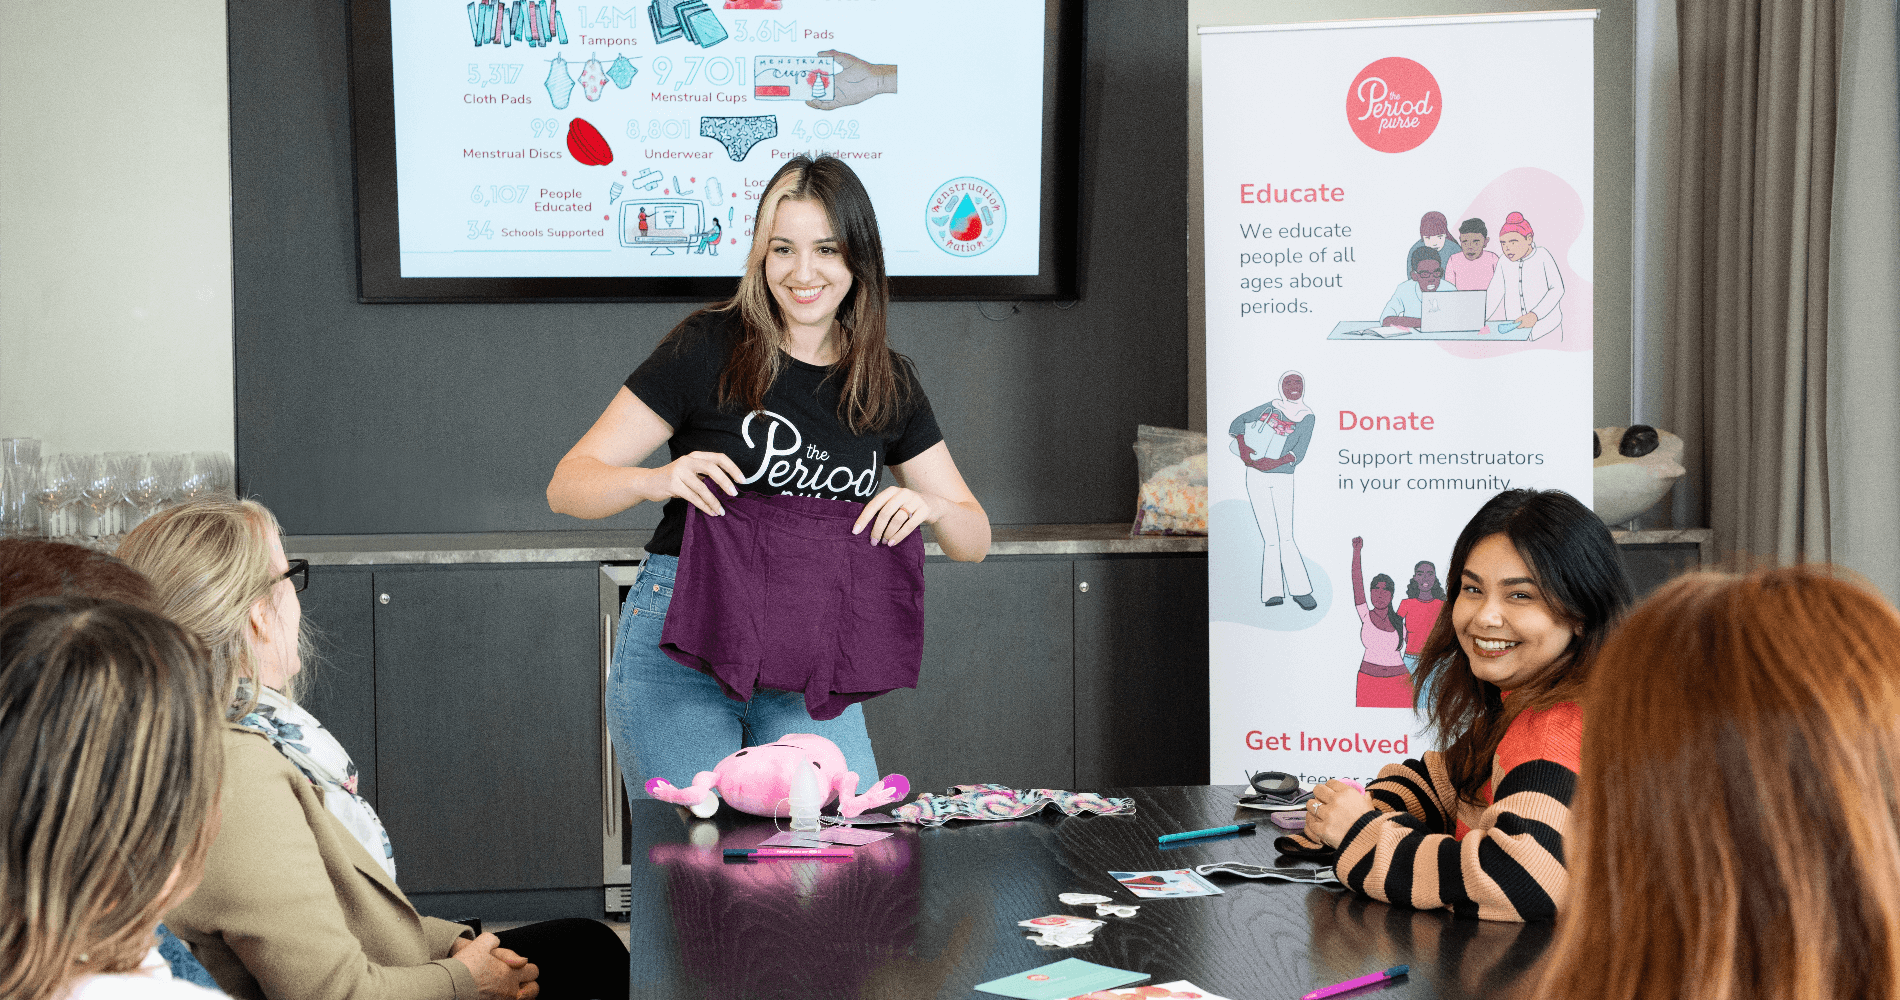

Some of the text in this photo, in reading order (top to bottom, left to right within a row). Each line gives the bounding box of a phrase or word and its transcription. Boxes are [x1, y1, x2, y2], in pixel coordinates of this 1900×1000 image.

[577, 5, 637, 29] 1.4M
[579, 35, 637, 47] Tampons
[733, 19, 798, 43] 3.6M
[804, 28, 835, 40] Pads
[467, 63, 524, 89] 5,317
[651, 55, 747, 92] 9,701
[463, 93, 532, 104] Cloth Pads
[651, 92, 747, 105] Menstrual Cups
[1357, 77, 1434, 121] Period
[530, 117, 560, 139] 99
[625, 118, 691, 143] 8,801
[790, 118, 861, 144] 4,042
[1378, 117, 1421, 134] purse
[463, 148, 563, 159] Menstrual Discs
[644, 149, 714, 159] Underwear
[815, 149, 883, 159] Uderwear
[470, 184, 530, 208] 6,107
[540, 188, 582, 201] People
[1240, 183, 1345, 204] Educate
[534, 201, 592, 212] Educated
[501, 228, 604, 239] Schools Supported
[1239, 222, 1352, 239] We educate
[1240, 246, 1356, 268] people of all
[1240, 272, 1343, 293] ages about
[1241, 298, 1314, 317] periods.
[1339, 410, 1435, 431] Donate
[741, 410, 879, 497] Period
[806, 443, 830, 461] the
[1338, 448, 1544, 469] Support menstruators
[1339, 474, 1354, 490] in
[1360, 478, 1402, 494] your
[1245, 729, 1409, 755] Get Involved
